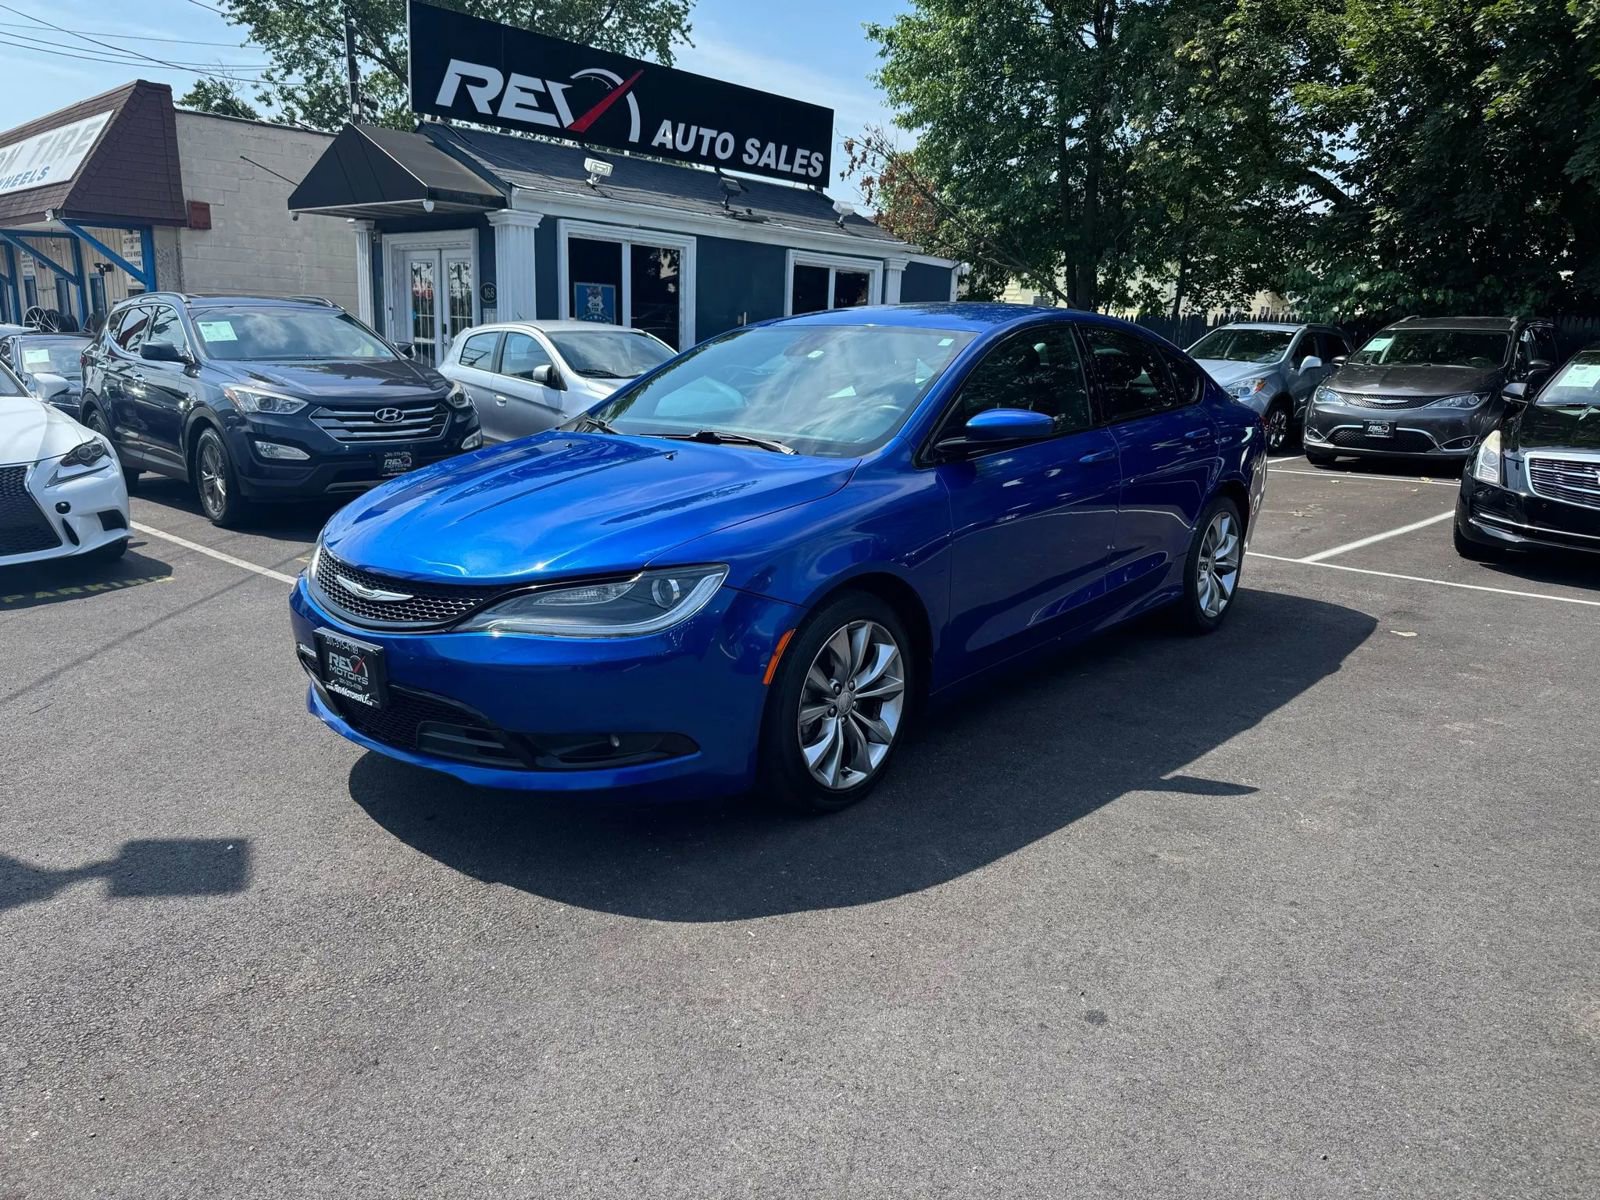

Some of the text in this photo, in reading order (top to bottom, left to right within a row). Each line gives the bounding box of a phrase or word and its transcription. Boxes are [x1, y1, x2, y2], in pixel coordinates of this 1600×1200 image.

[435, 58, 825, 178] REV AUTO SALES
[26, 119, 105, 168] TIRE
[329, 651, 366, 673] REV
[329, 664, 369, 686] MOTORS
